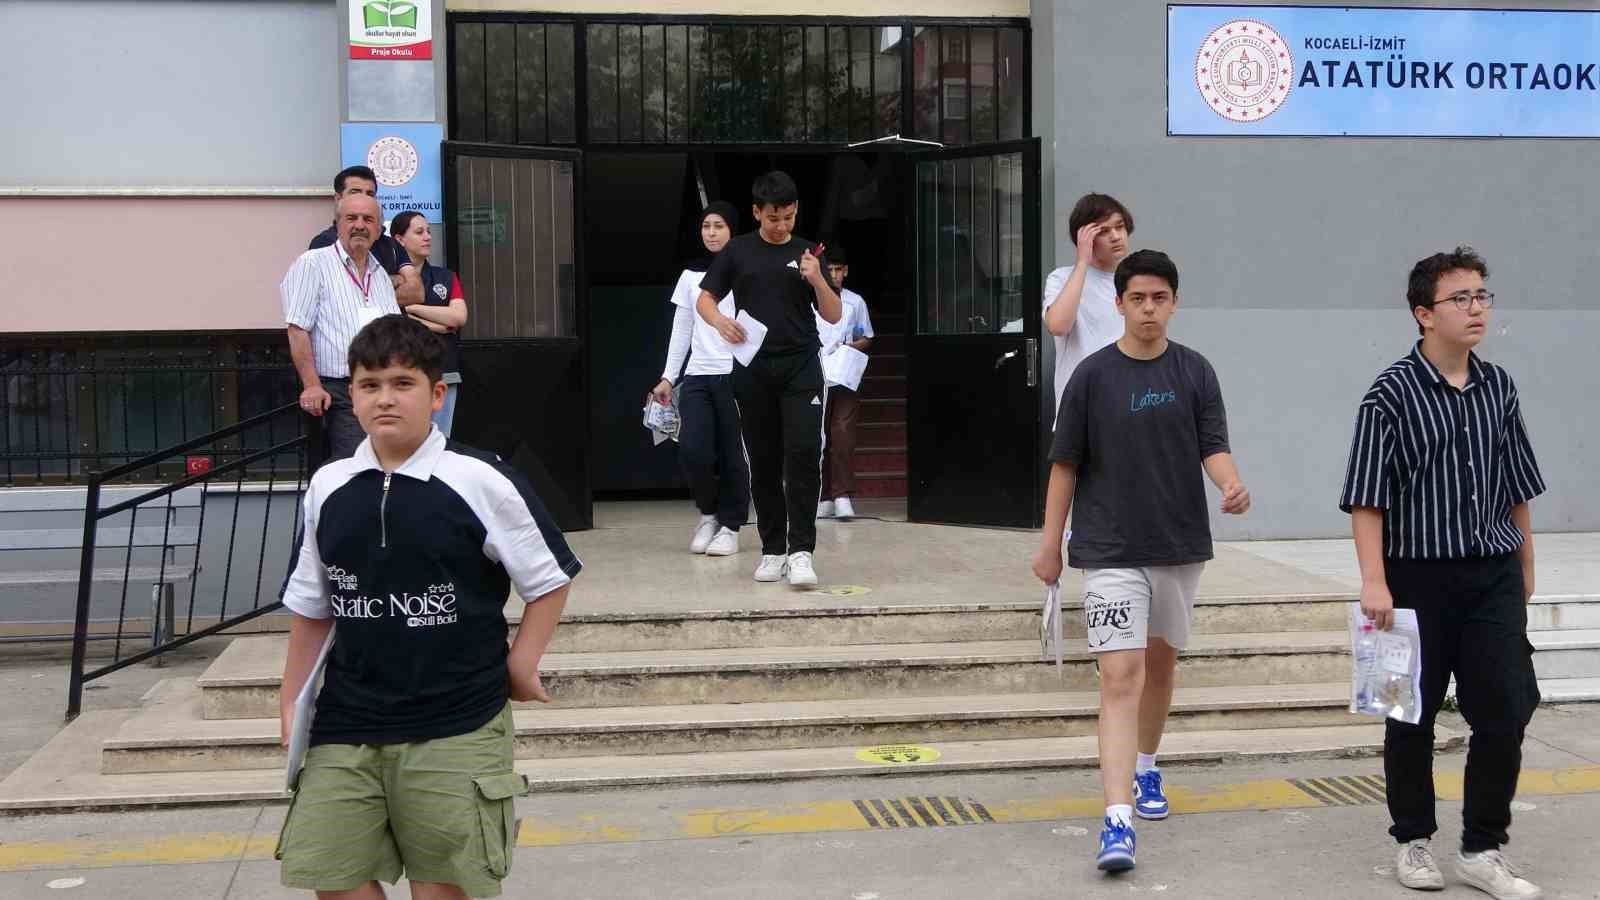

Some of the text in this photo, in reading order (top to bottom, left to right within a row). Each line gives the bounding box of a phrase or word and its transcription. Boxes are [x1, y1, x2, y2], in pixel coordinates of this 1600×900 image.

[371, 48, 413, 56] Proje Okulu
[1304, 35, 1406, 50] KOCAELİ-İZMİT
[1298, 54, 1454, 89] ATATÜRK
[1465, 62, 1600, 90] ORTAOK
[389, 202, 441, 210] ORTAOKULU
[1130, 387, 1176, 412] Lakers
[331, 592, 456, 618] Static Noise
[1088, 607, 1131, 630] ERS
